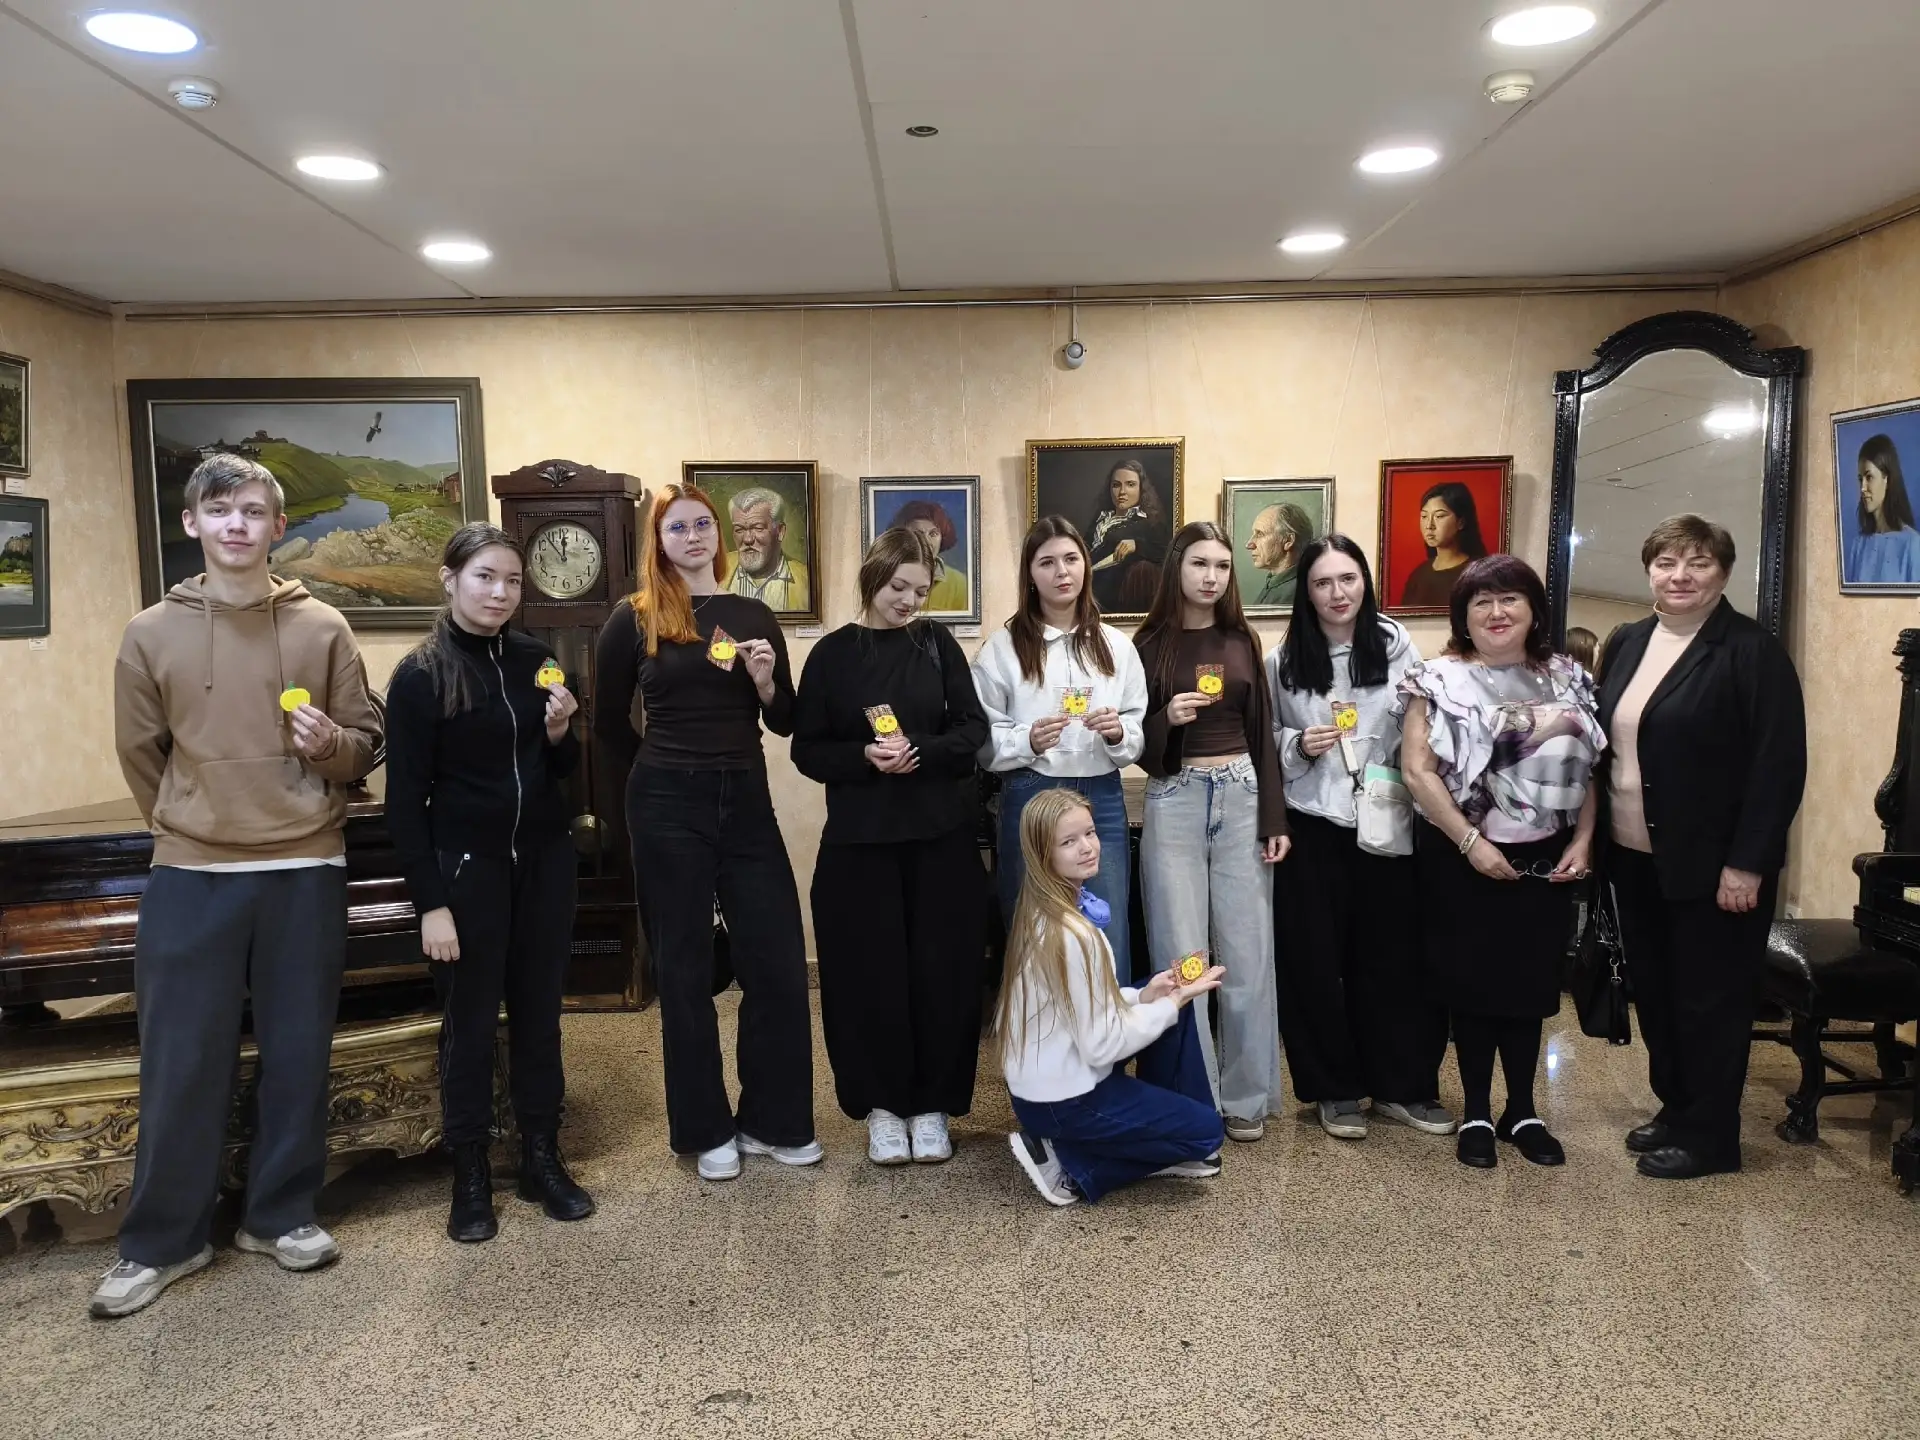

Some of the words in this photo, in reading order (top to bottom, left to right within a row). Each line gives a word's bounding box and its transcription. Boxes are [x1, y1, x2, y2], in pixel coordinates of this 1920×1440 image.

[575, 530, 579, 543] 1
[538, 539, 547, 551] 10
[582, 538, 590, 551] 2
[534, 553, 543, 565] 9
[586, 551, 596, 564] 3
[540, 566, 548, 578] 8
[583, 565, 591, 577] 4
[550, 575, 558, 588] 7
[562, 577, 571, 590] 6
[575, 575, 583, 588] 5
